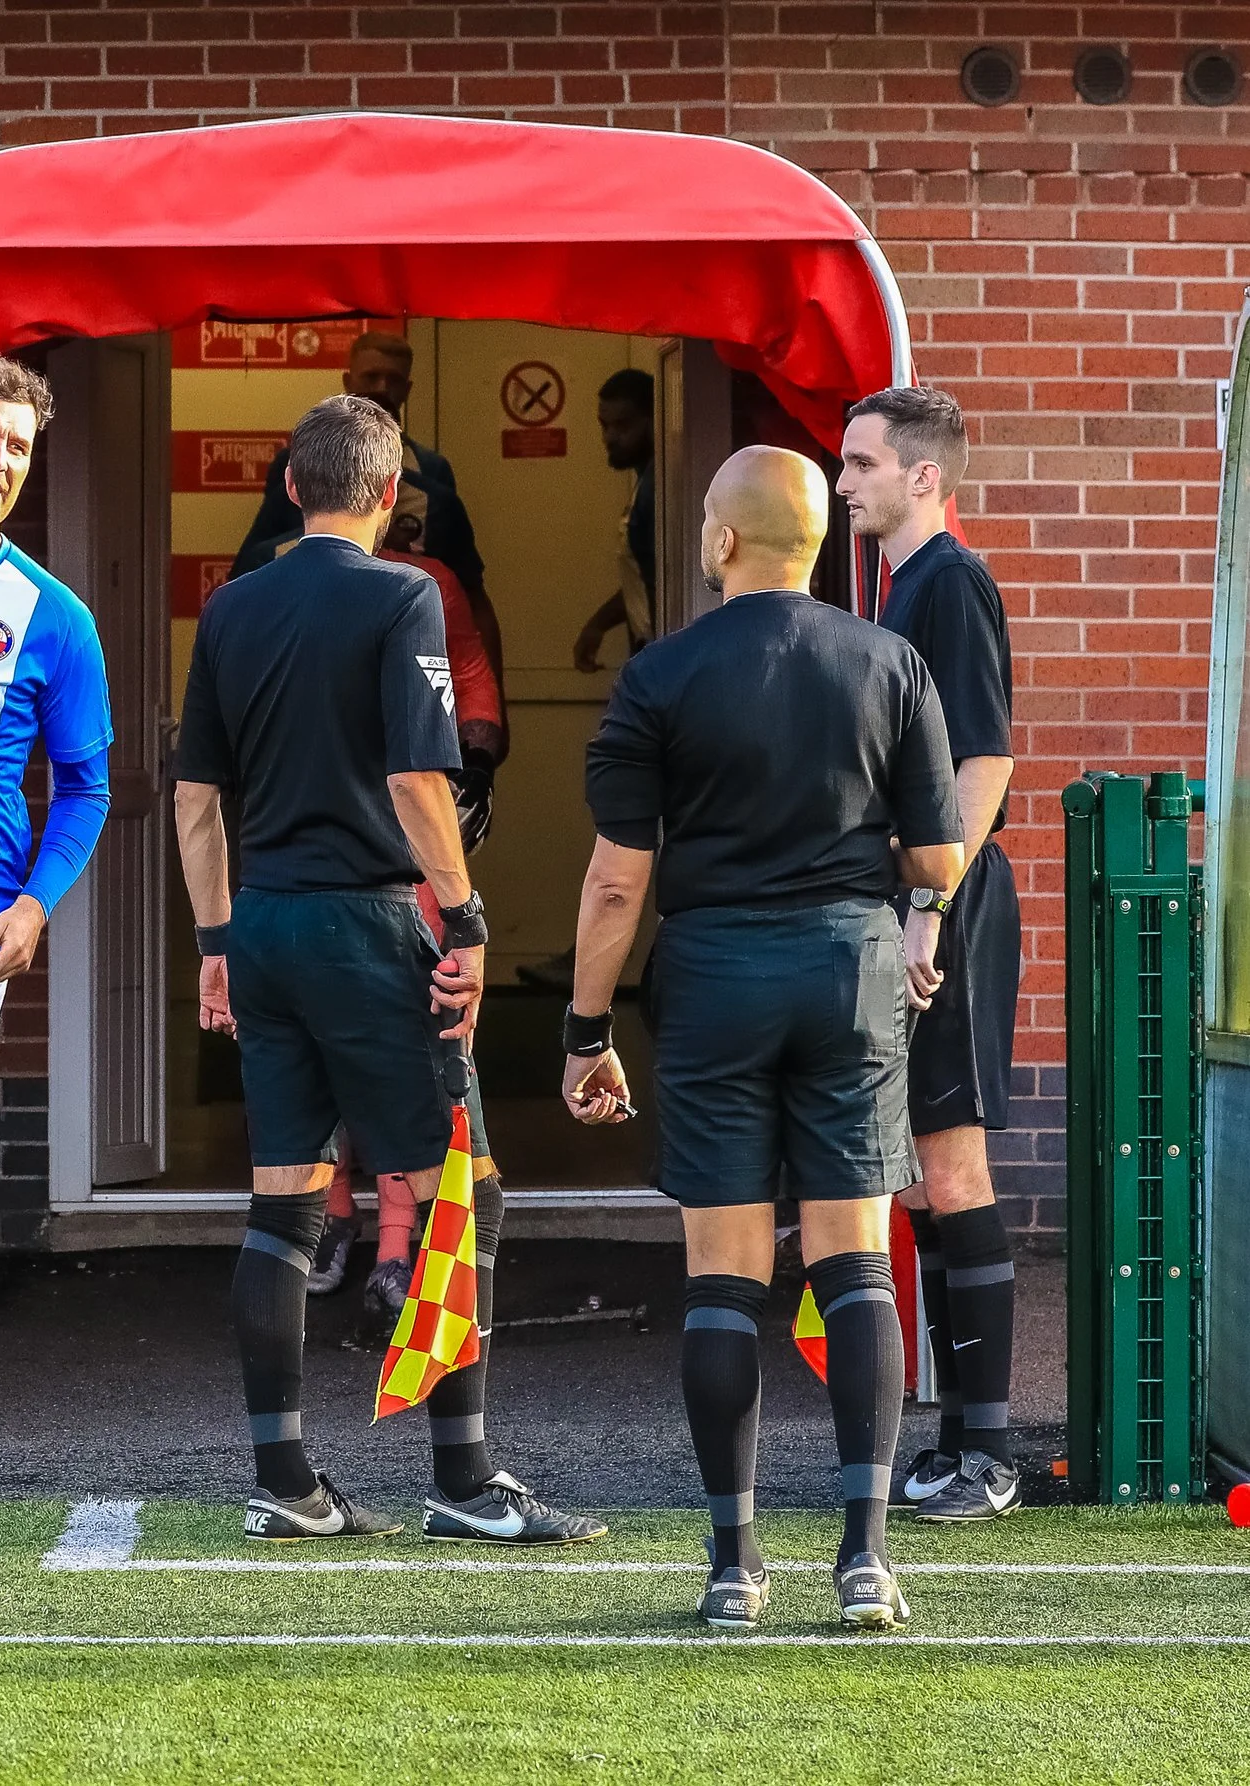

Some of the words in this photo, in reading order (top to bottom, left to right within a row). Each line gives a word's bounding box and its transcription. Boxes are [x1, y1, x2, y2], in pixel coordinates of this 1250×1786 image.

[213, 442, 275, 462] PITCHING
[242, 461, 257, 481] IN
[244, 1510, 272, 1533] IKE
[854, 1582, 878, 1594] NIKE
[723, 1598, 747, 1611] NIKE
